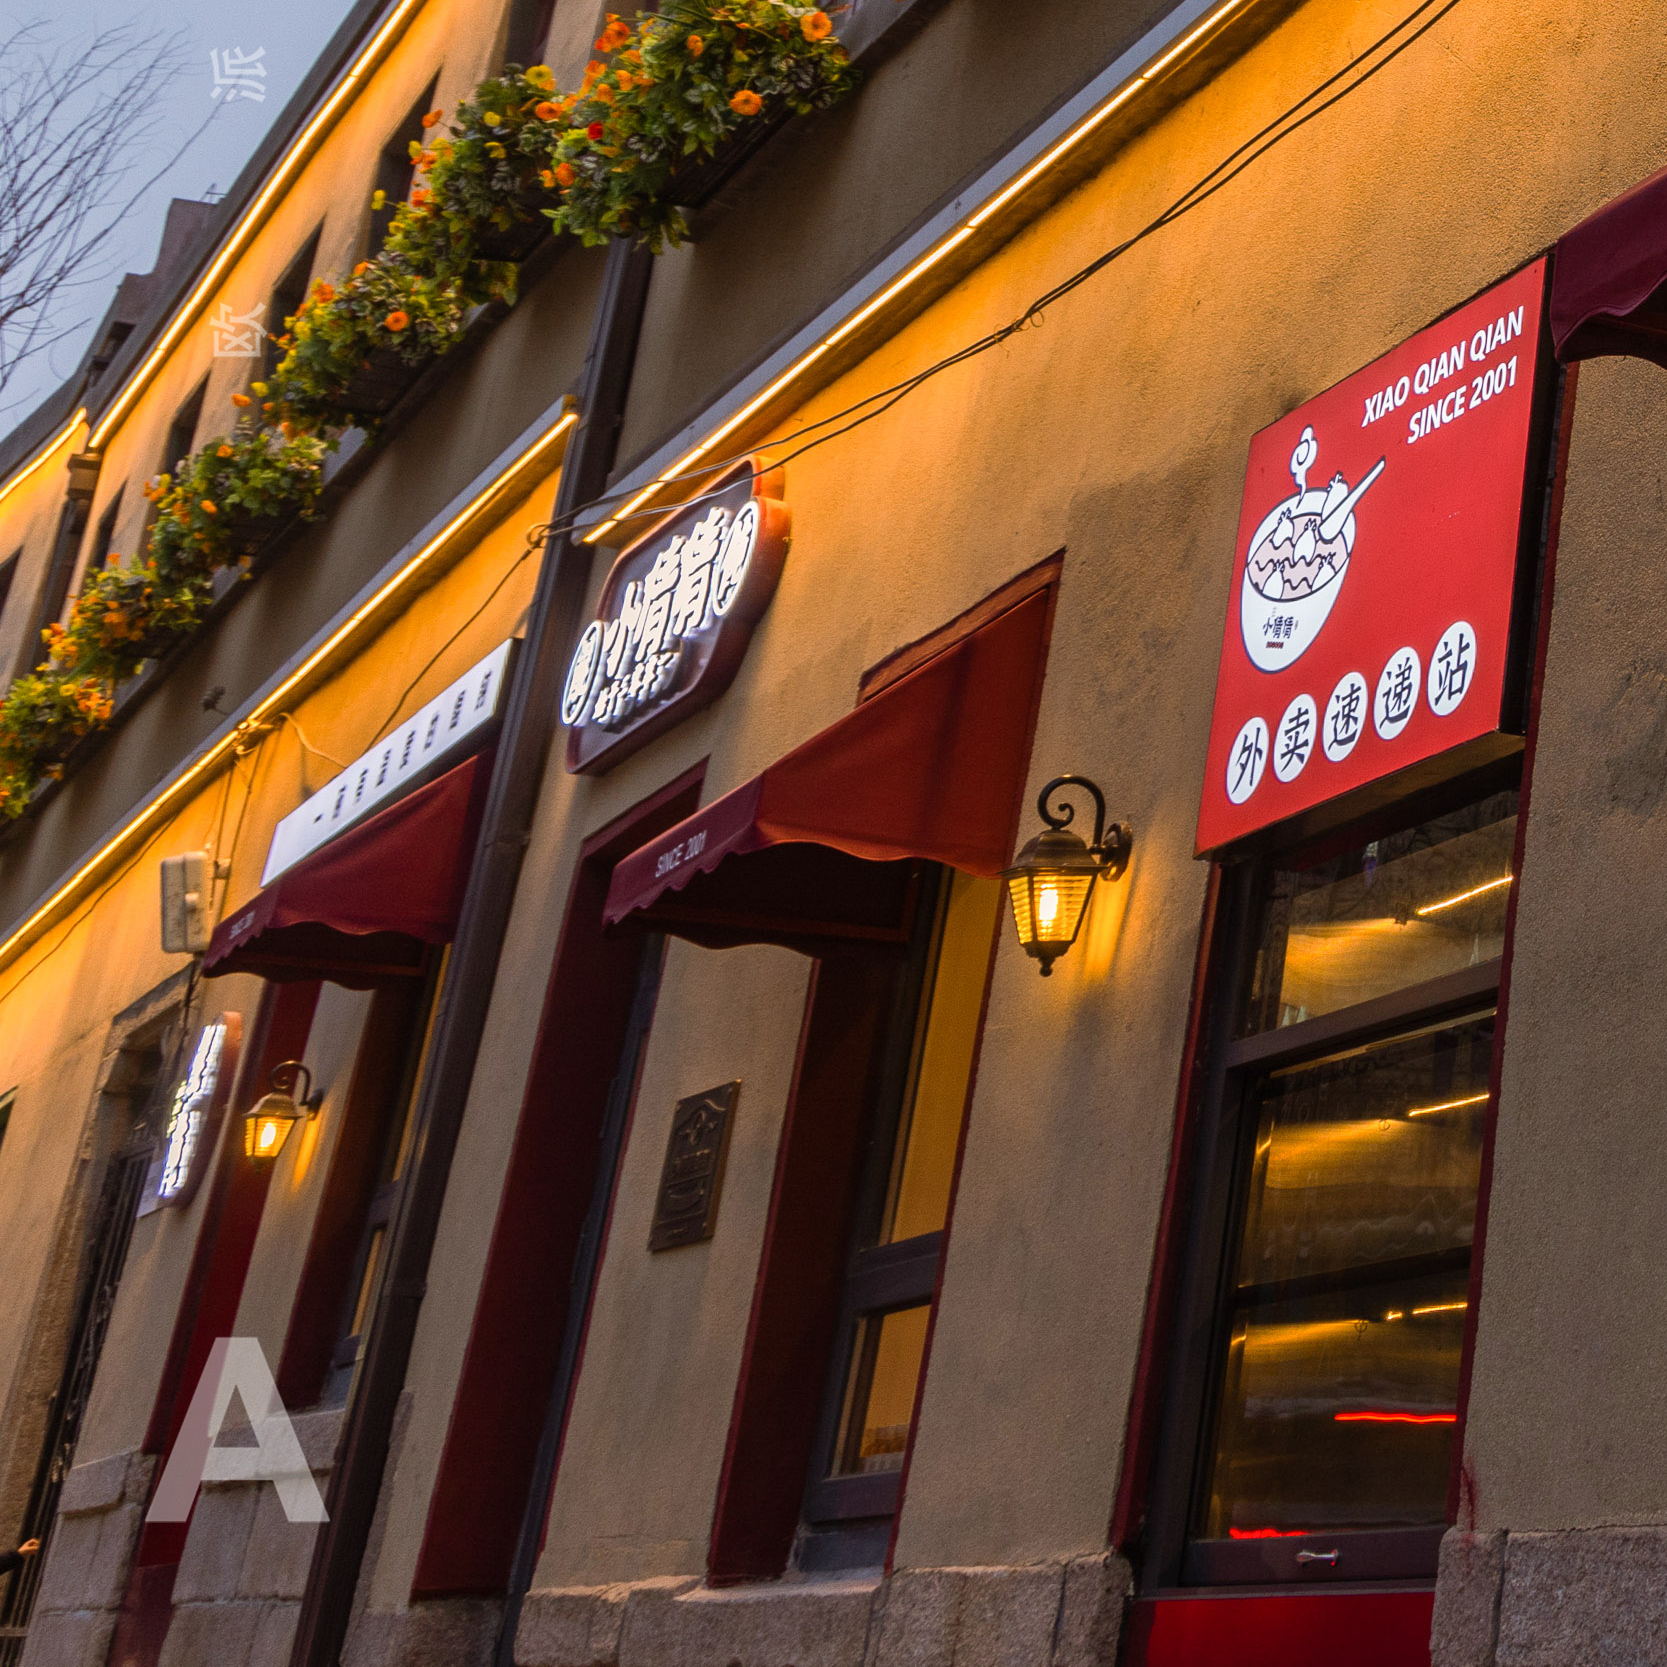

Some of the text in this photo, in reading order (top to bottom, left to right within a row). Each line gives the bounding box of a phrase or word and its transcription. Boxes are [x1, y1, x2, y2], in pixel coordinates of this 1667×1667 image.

[1361, 305, 1525, 428] XIAO QIAN QIAN
[1406, 355, 1518, 445] SINCE 2001
[1231, 632, 1471, 794] 外卖速递站
[655, 842, 685, 878] SINCE
